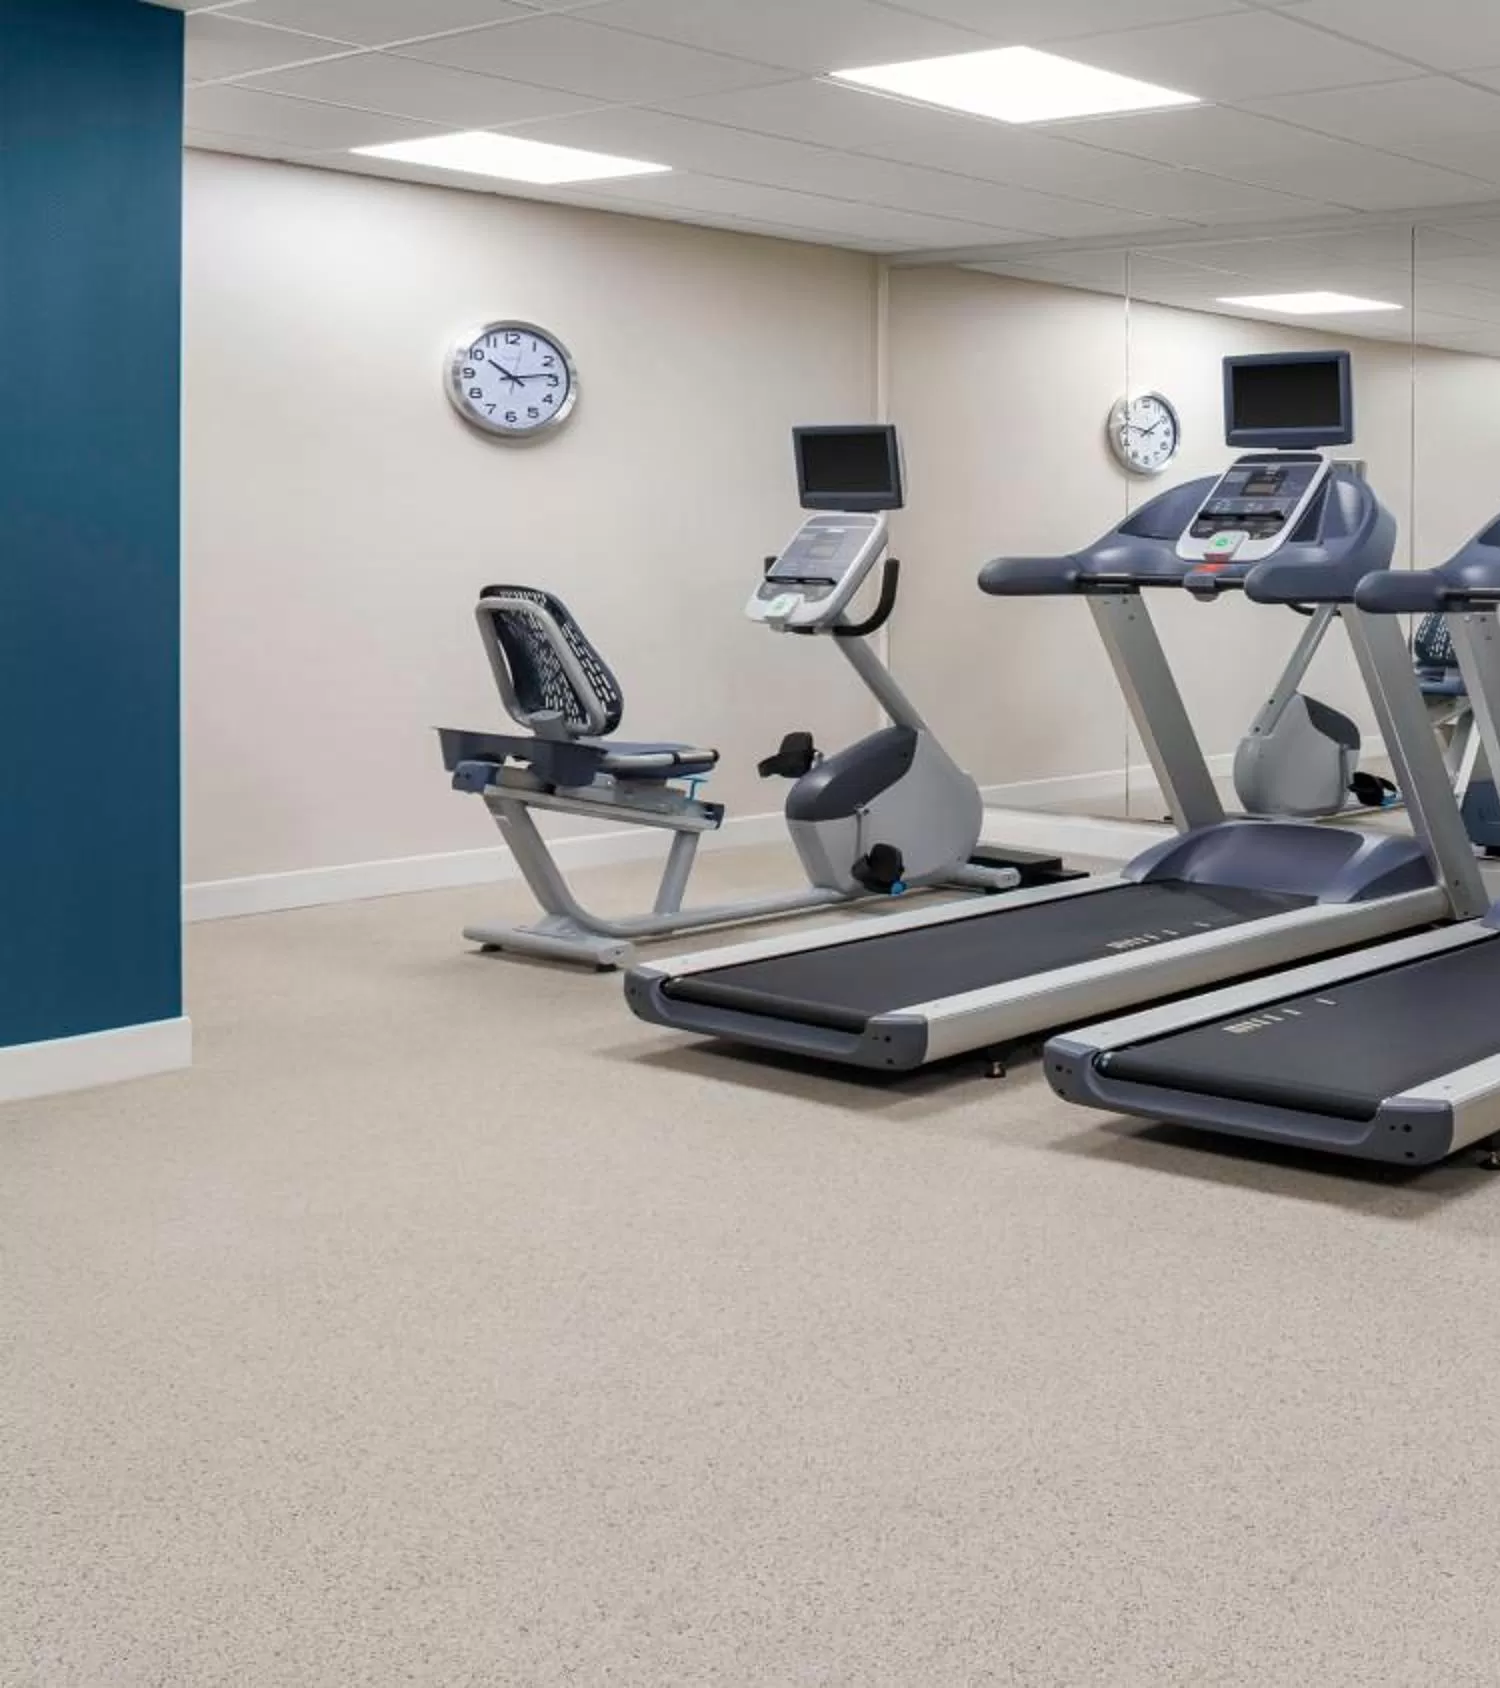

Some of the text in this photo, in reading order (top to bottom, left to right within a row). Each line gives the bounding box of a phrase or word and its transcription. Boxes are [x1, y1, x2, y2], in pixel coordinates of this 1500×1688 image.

[486, 336, 497, 348] 11
[505, 333, 521, 345] 12
[469, 348, 485, 360] 10
[542, 355, 555, 367] 2
[462, 367, 476, 379] 9
[547, 374, 559, 387] 3
[469, 387, 483, 399] 8
[542, 393, 553, 404] 4
[485, 404, 496, 415] 7
[527, 407, 540, 418] 5
[505, 411, 517, 423] 6
